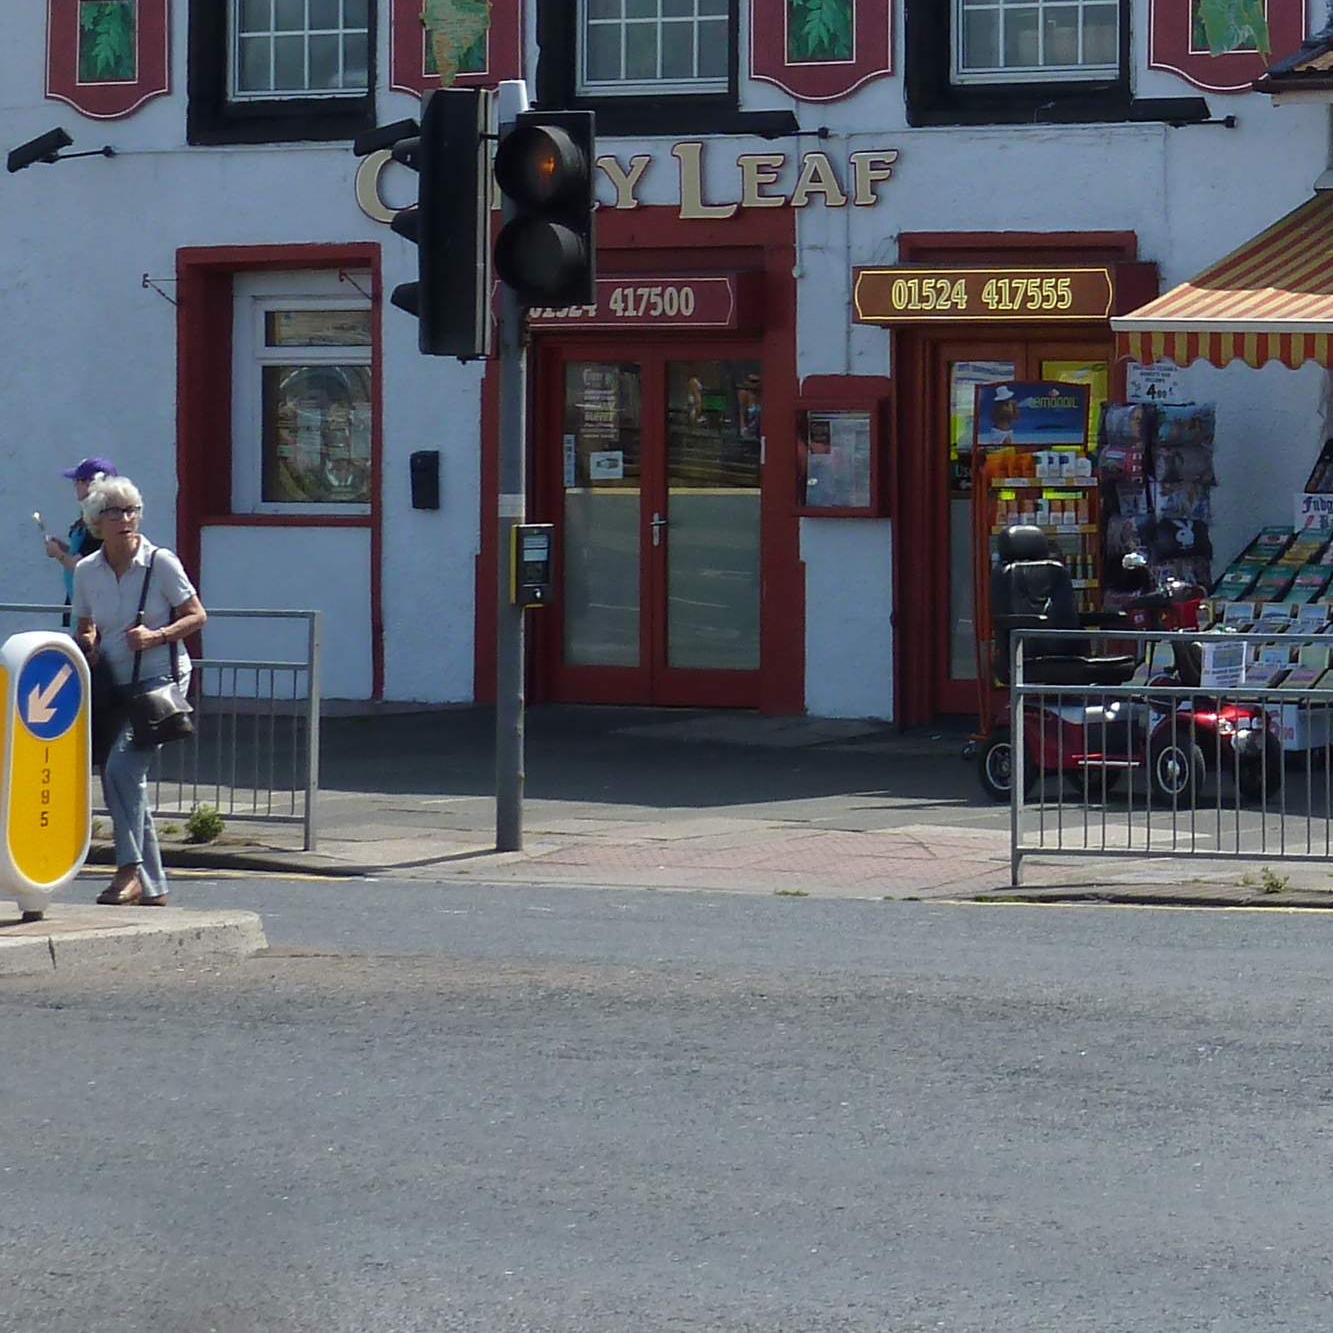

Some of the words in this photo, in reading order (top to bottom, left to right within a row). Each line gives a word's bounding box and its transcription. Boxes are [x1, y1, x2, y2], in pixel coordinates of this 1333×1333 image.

[670, 140, 899, 221] LEAF
[609, 286, 695, 317] 417500
[892, 278, 967, 311] 01524
[981, 277, 1073, 310] 417555
